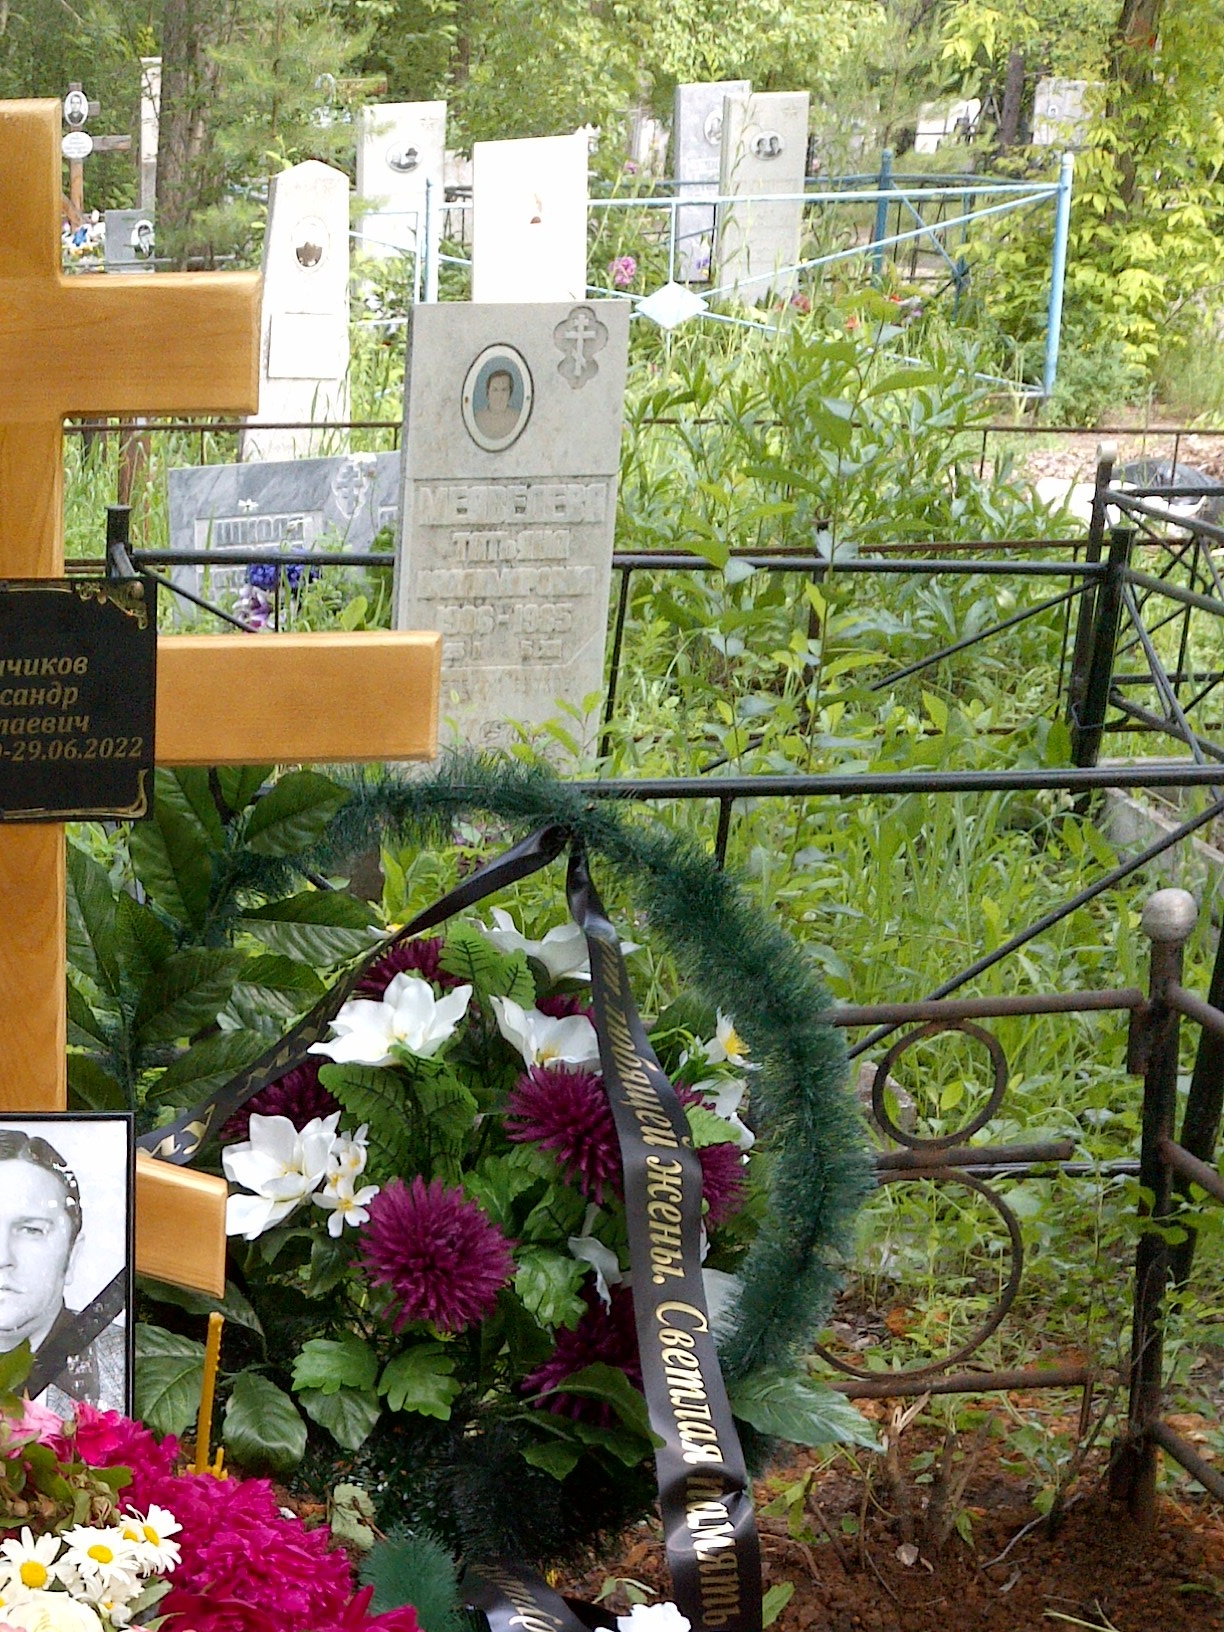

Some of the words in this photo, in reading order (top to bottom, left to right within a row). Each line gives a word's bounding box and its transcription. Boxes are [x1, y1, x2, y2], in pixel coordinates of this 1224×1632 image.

[644, 1154, 701, 1287] жены.
[656, 1298, 725, 1465] Светлая
[683, 1468, 742, 1628] память
